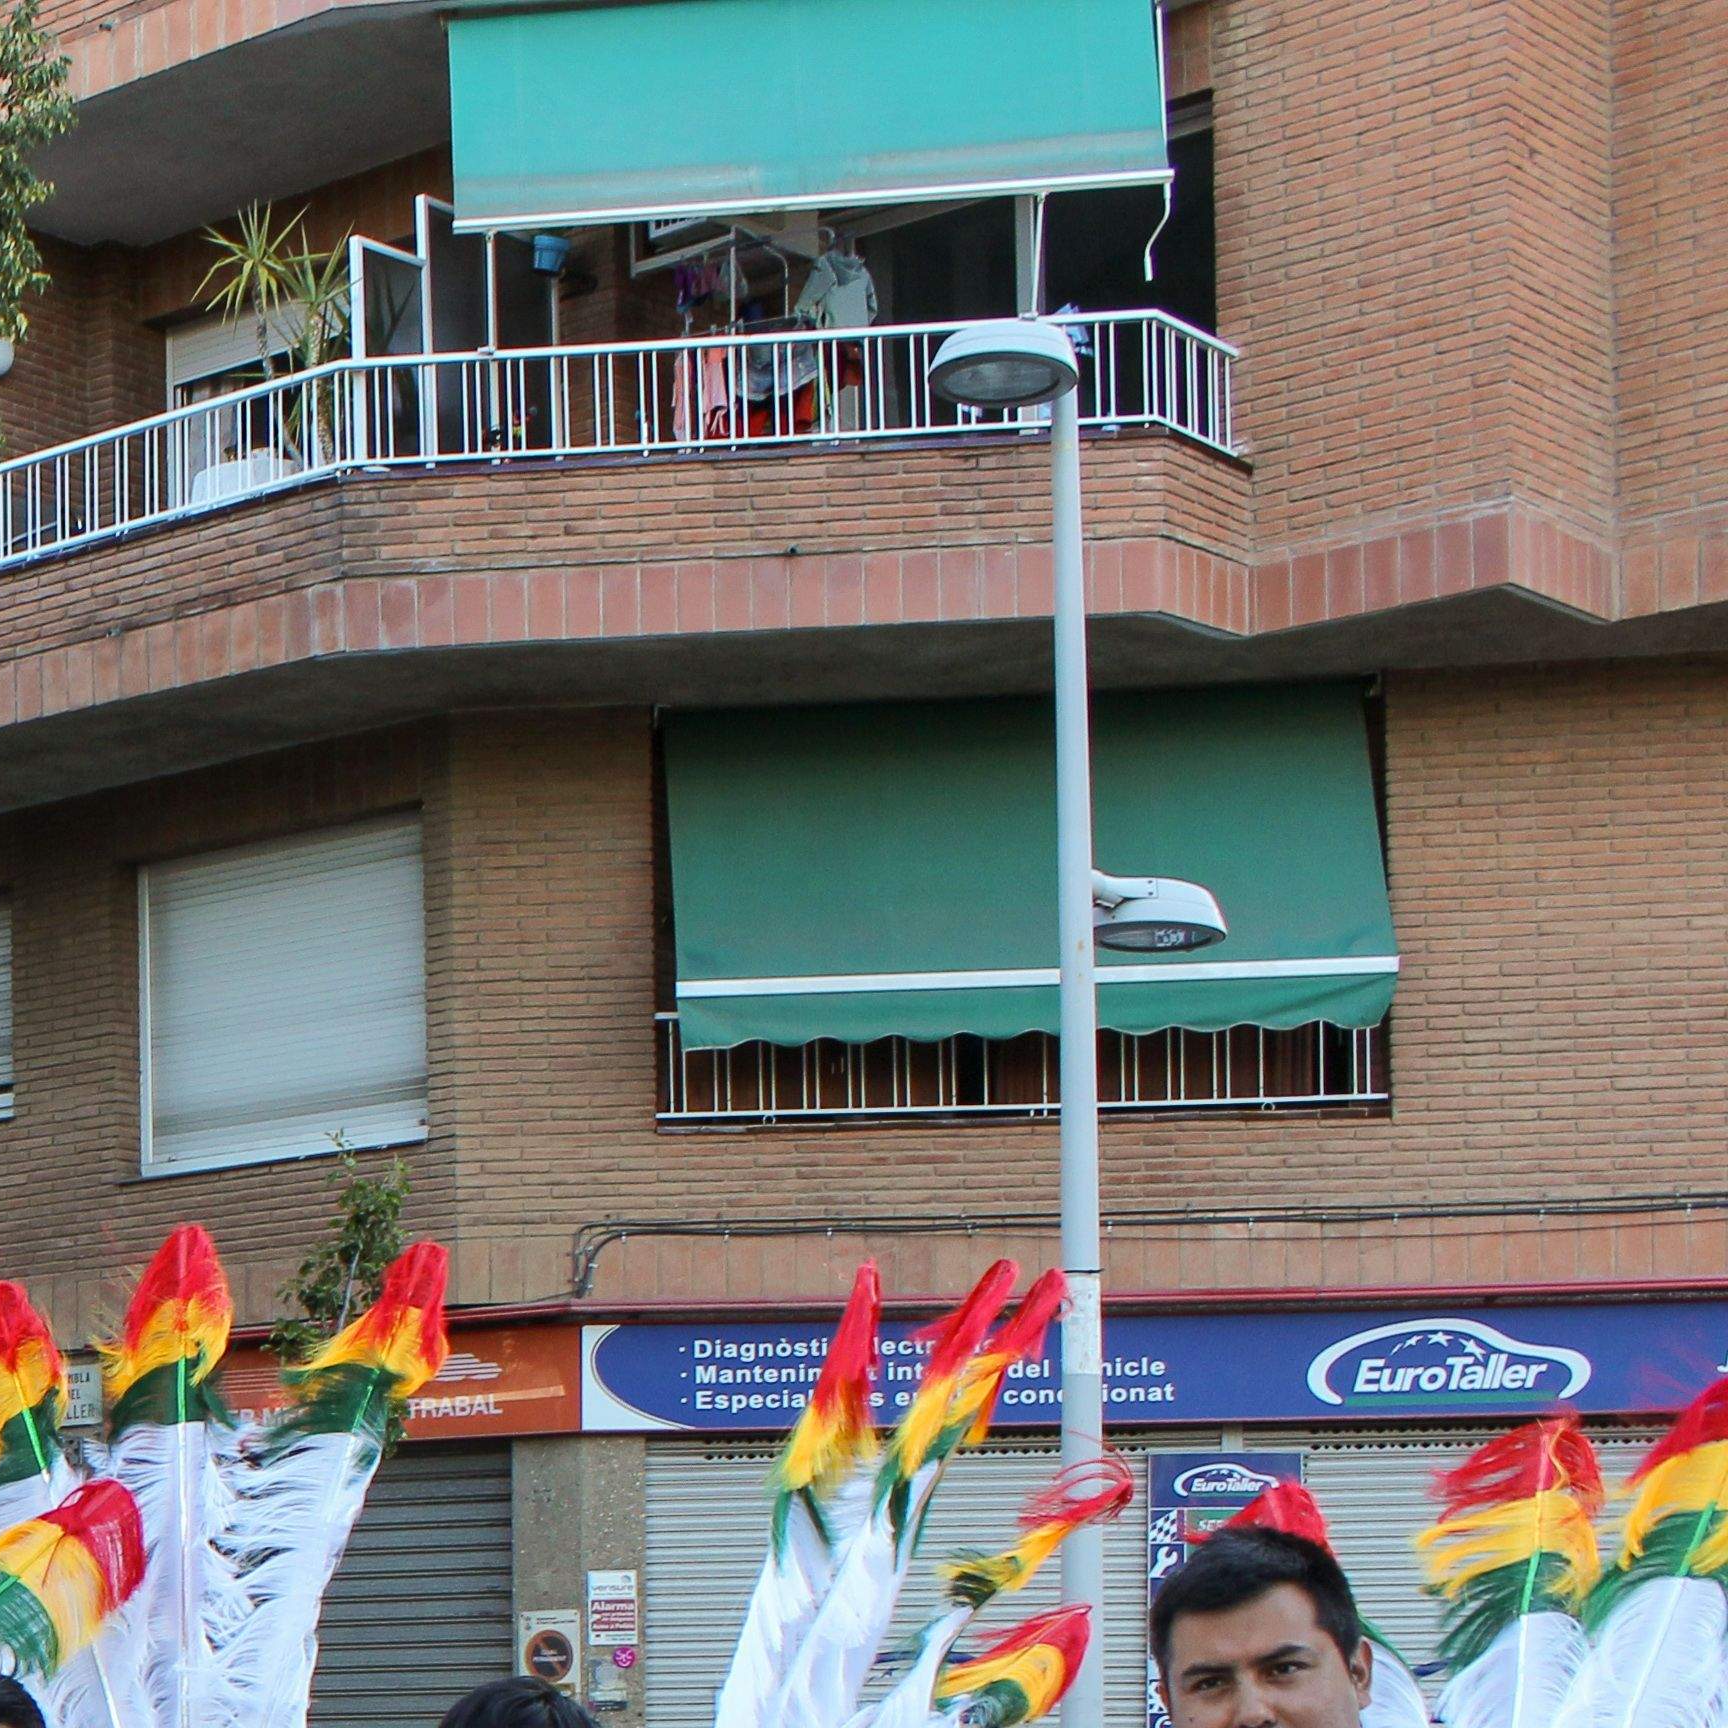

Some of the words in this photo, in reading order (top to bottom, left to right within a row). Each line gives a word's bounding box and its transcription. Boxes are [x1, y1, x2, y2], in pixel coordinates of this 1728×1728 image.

[693, 1337, 828, 1362] Diagnòsti
[1006, 1358, 1051, 1380] del
[1352, 1353, 1548, 1394] EuroTaller
